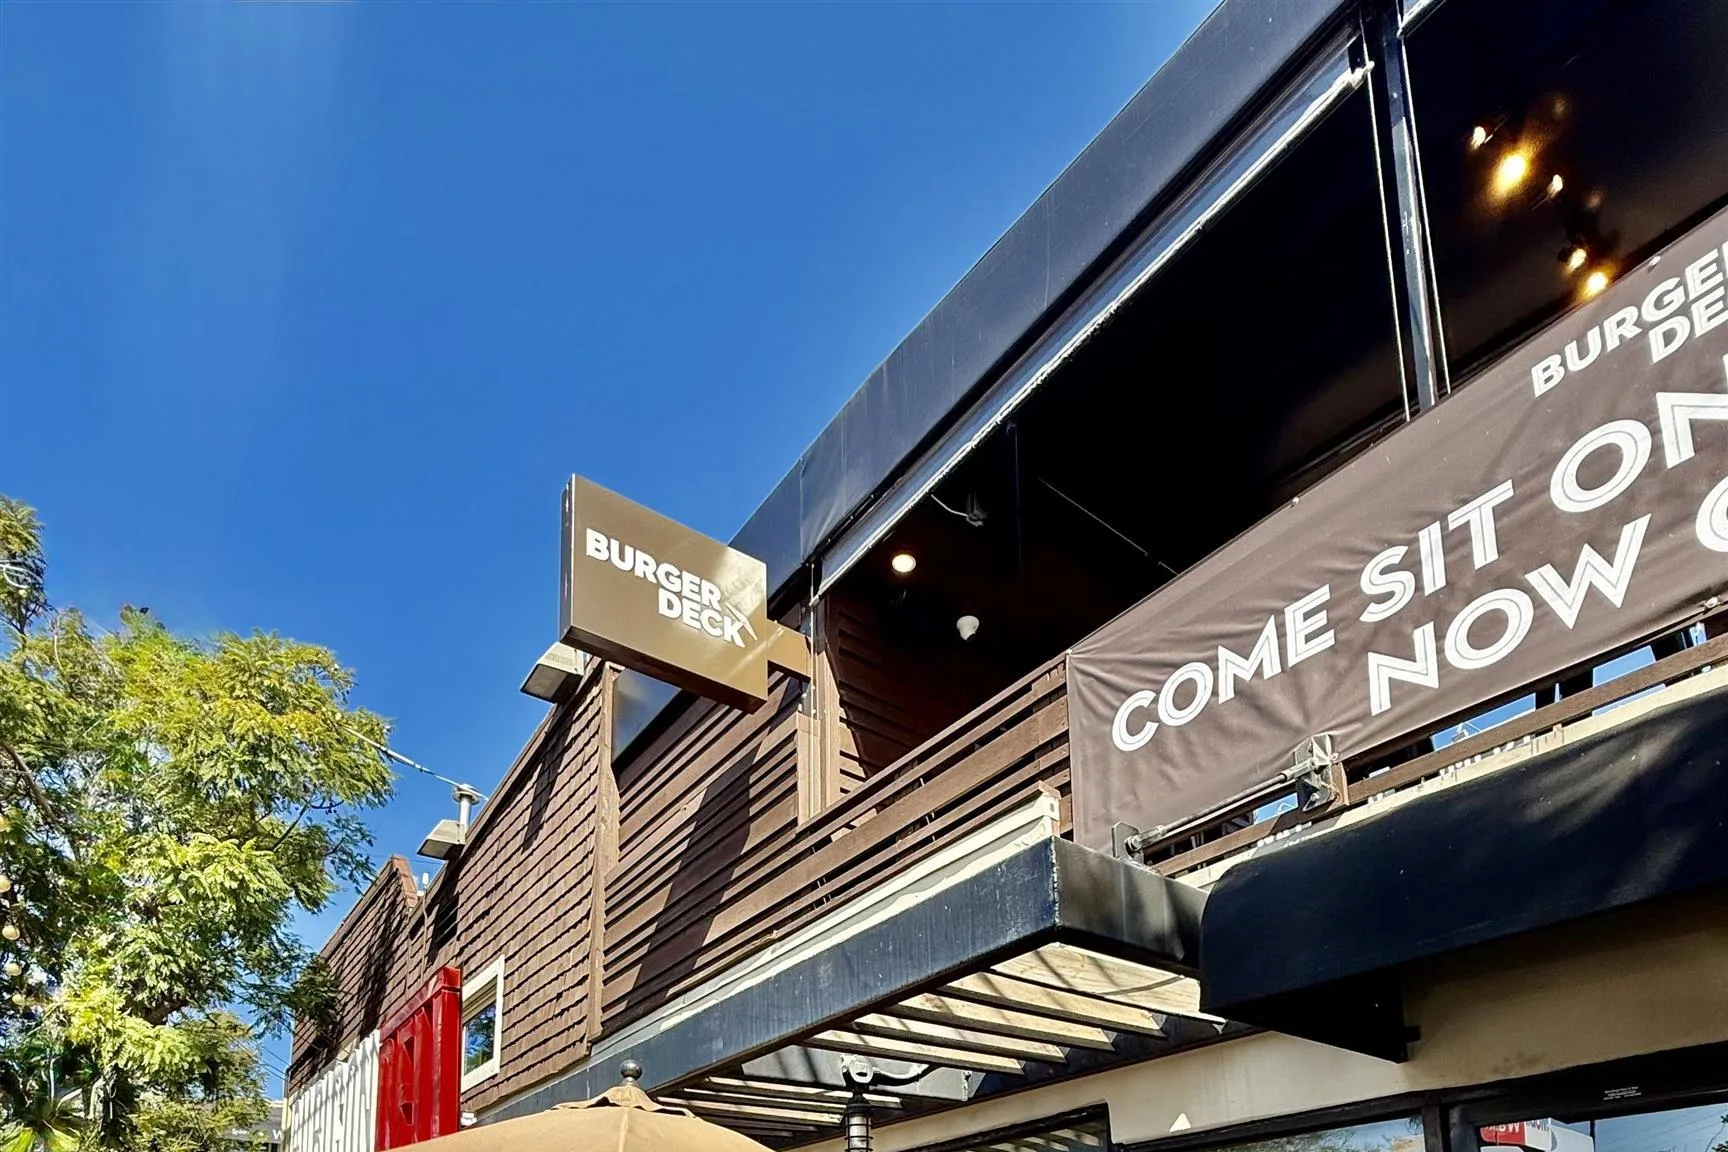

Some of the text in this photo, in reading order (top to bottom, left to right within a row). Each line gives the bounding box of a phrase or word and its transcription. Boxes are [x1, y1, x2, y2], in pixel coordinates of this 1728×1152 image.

[1531, 241, 1728, 398] BURGE
[586, 528, 722, 610] BURGER
[658, 587, 746, 648] DECK
[1111, 584, 1336, 752] COME
[1359, 479, 1514, 623] SIT
[1367, 513, 1652, 716] NOW
